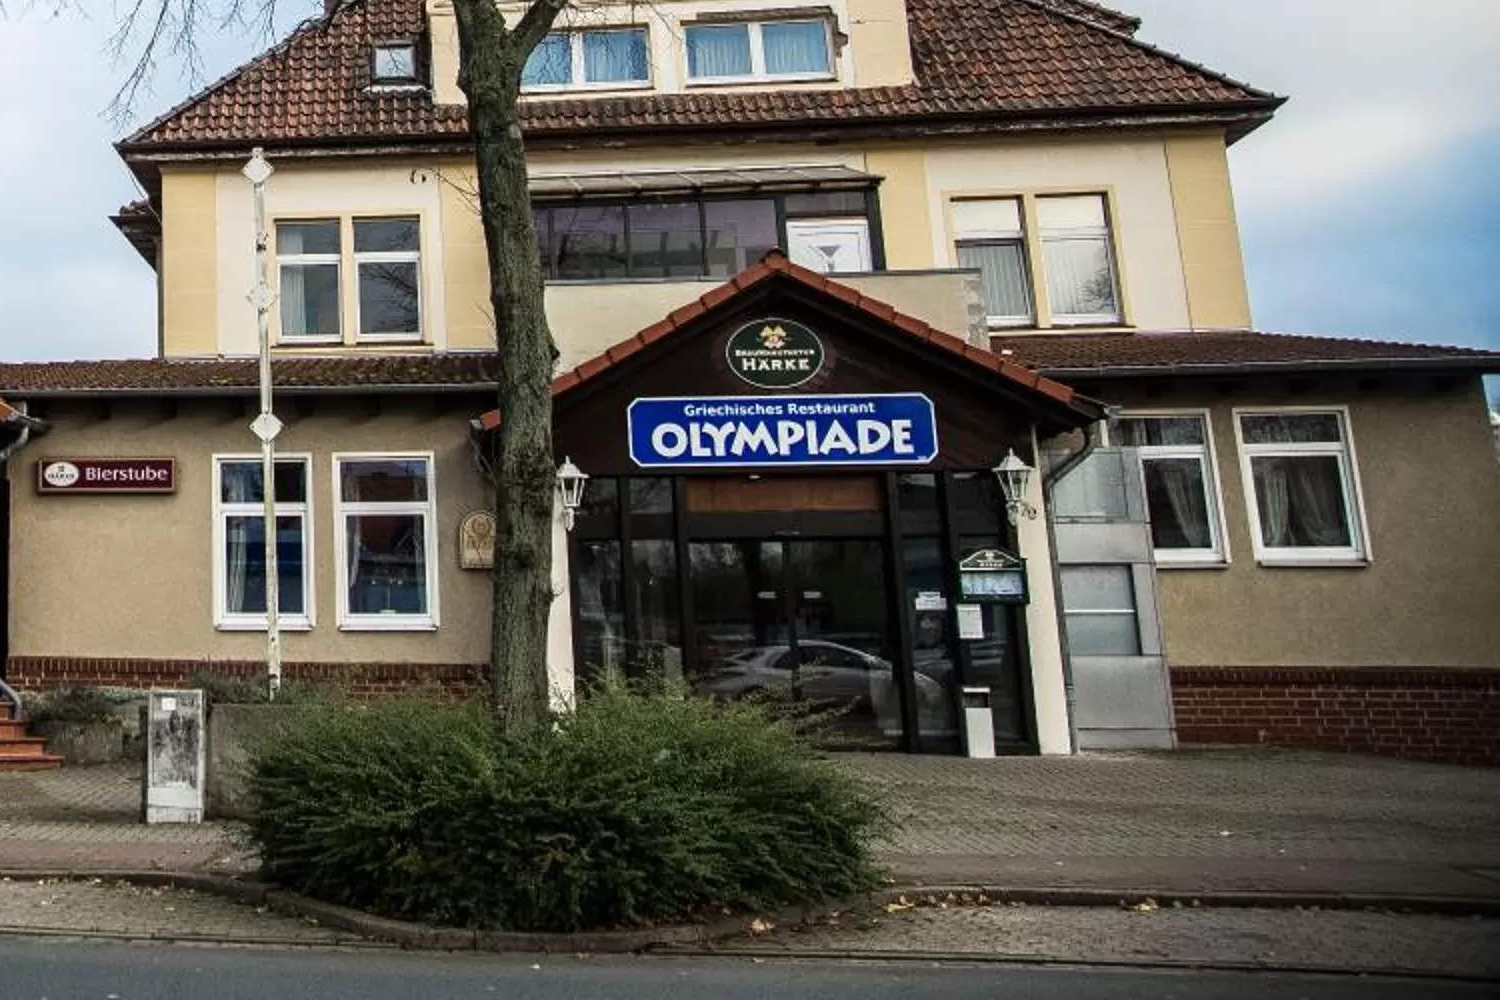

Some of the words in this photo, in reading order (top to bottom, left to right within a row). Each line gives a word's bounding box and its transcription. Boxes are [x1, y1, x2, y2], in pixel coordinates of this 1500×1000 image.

[742, 356, 811, 371] HÄRKE
[683, 403, 784, 418] Griechisches
[787, 401, 877, 416] Restaurant
[651, 418, 915, 458] OLYMPIADE
[85, 466, 169, 482] Bierstube
